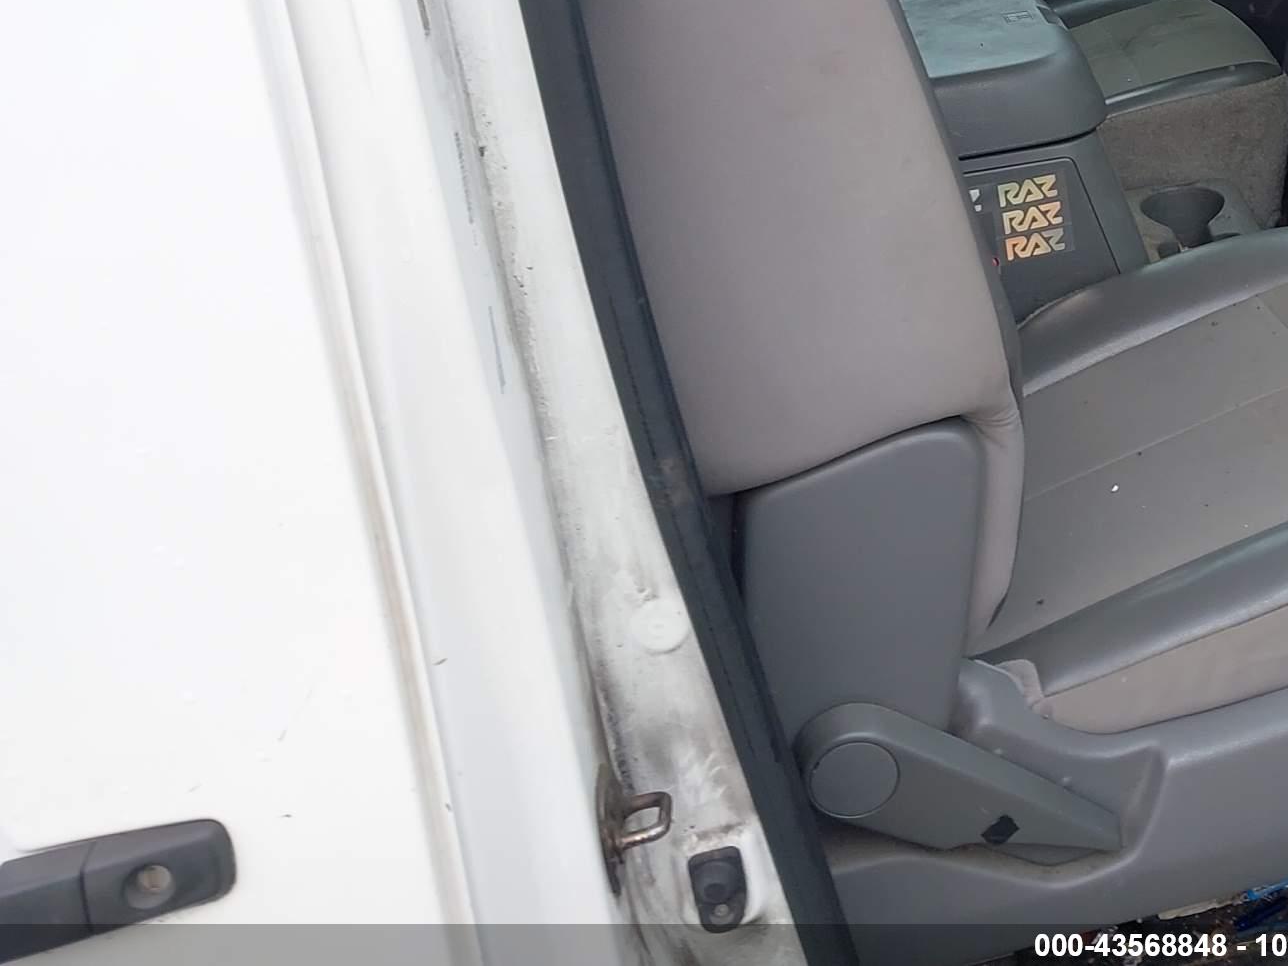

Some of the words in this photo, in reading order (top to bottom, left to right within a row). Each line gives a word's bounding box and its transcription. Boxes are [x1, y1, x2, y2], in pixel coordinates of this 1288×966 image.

[997, 174, 1058, 208] RAZ
[1002, 201, 1063, 235] RAZ
[1005, 227, 1065, 261] RAZ
